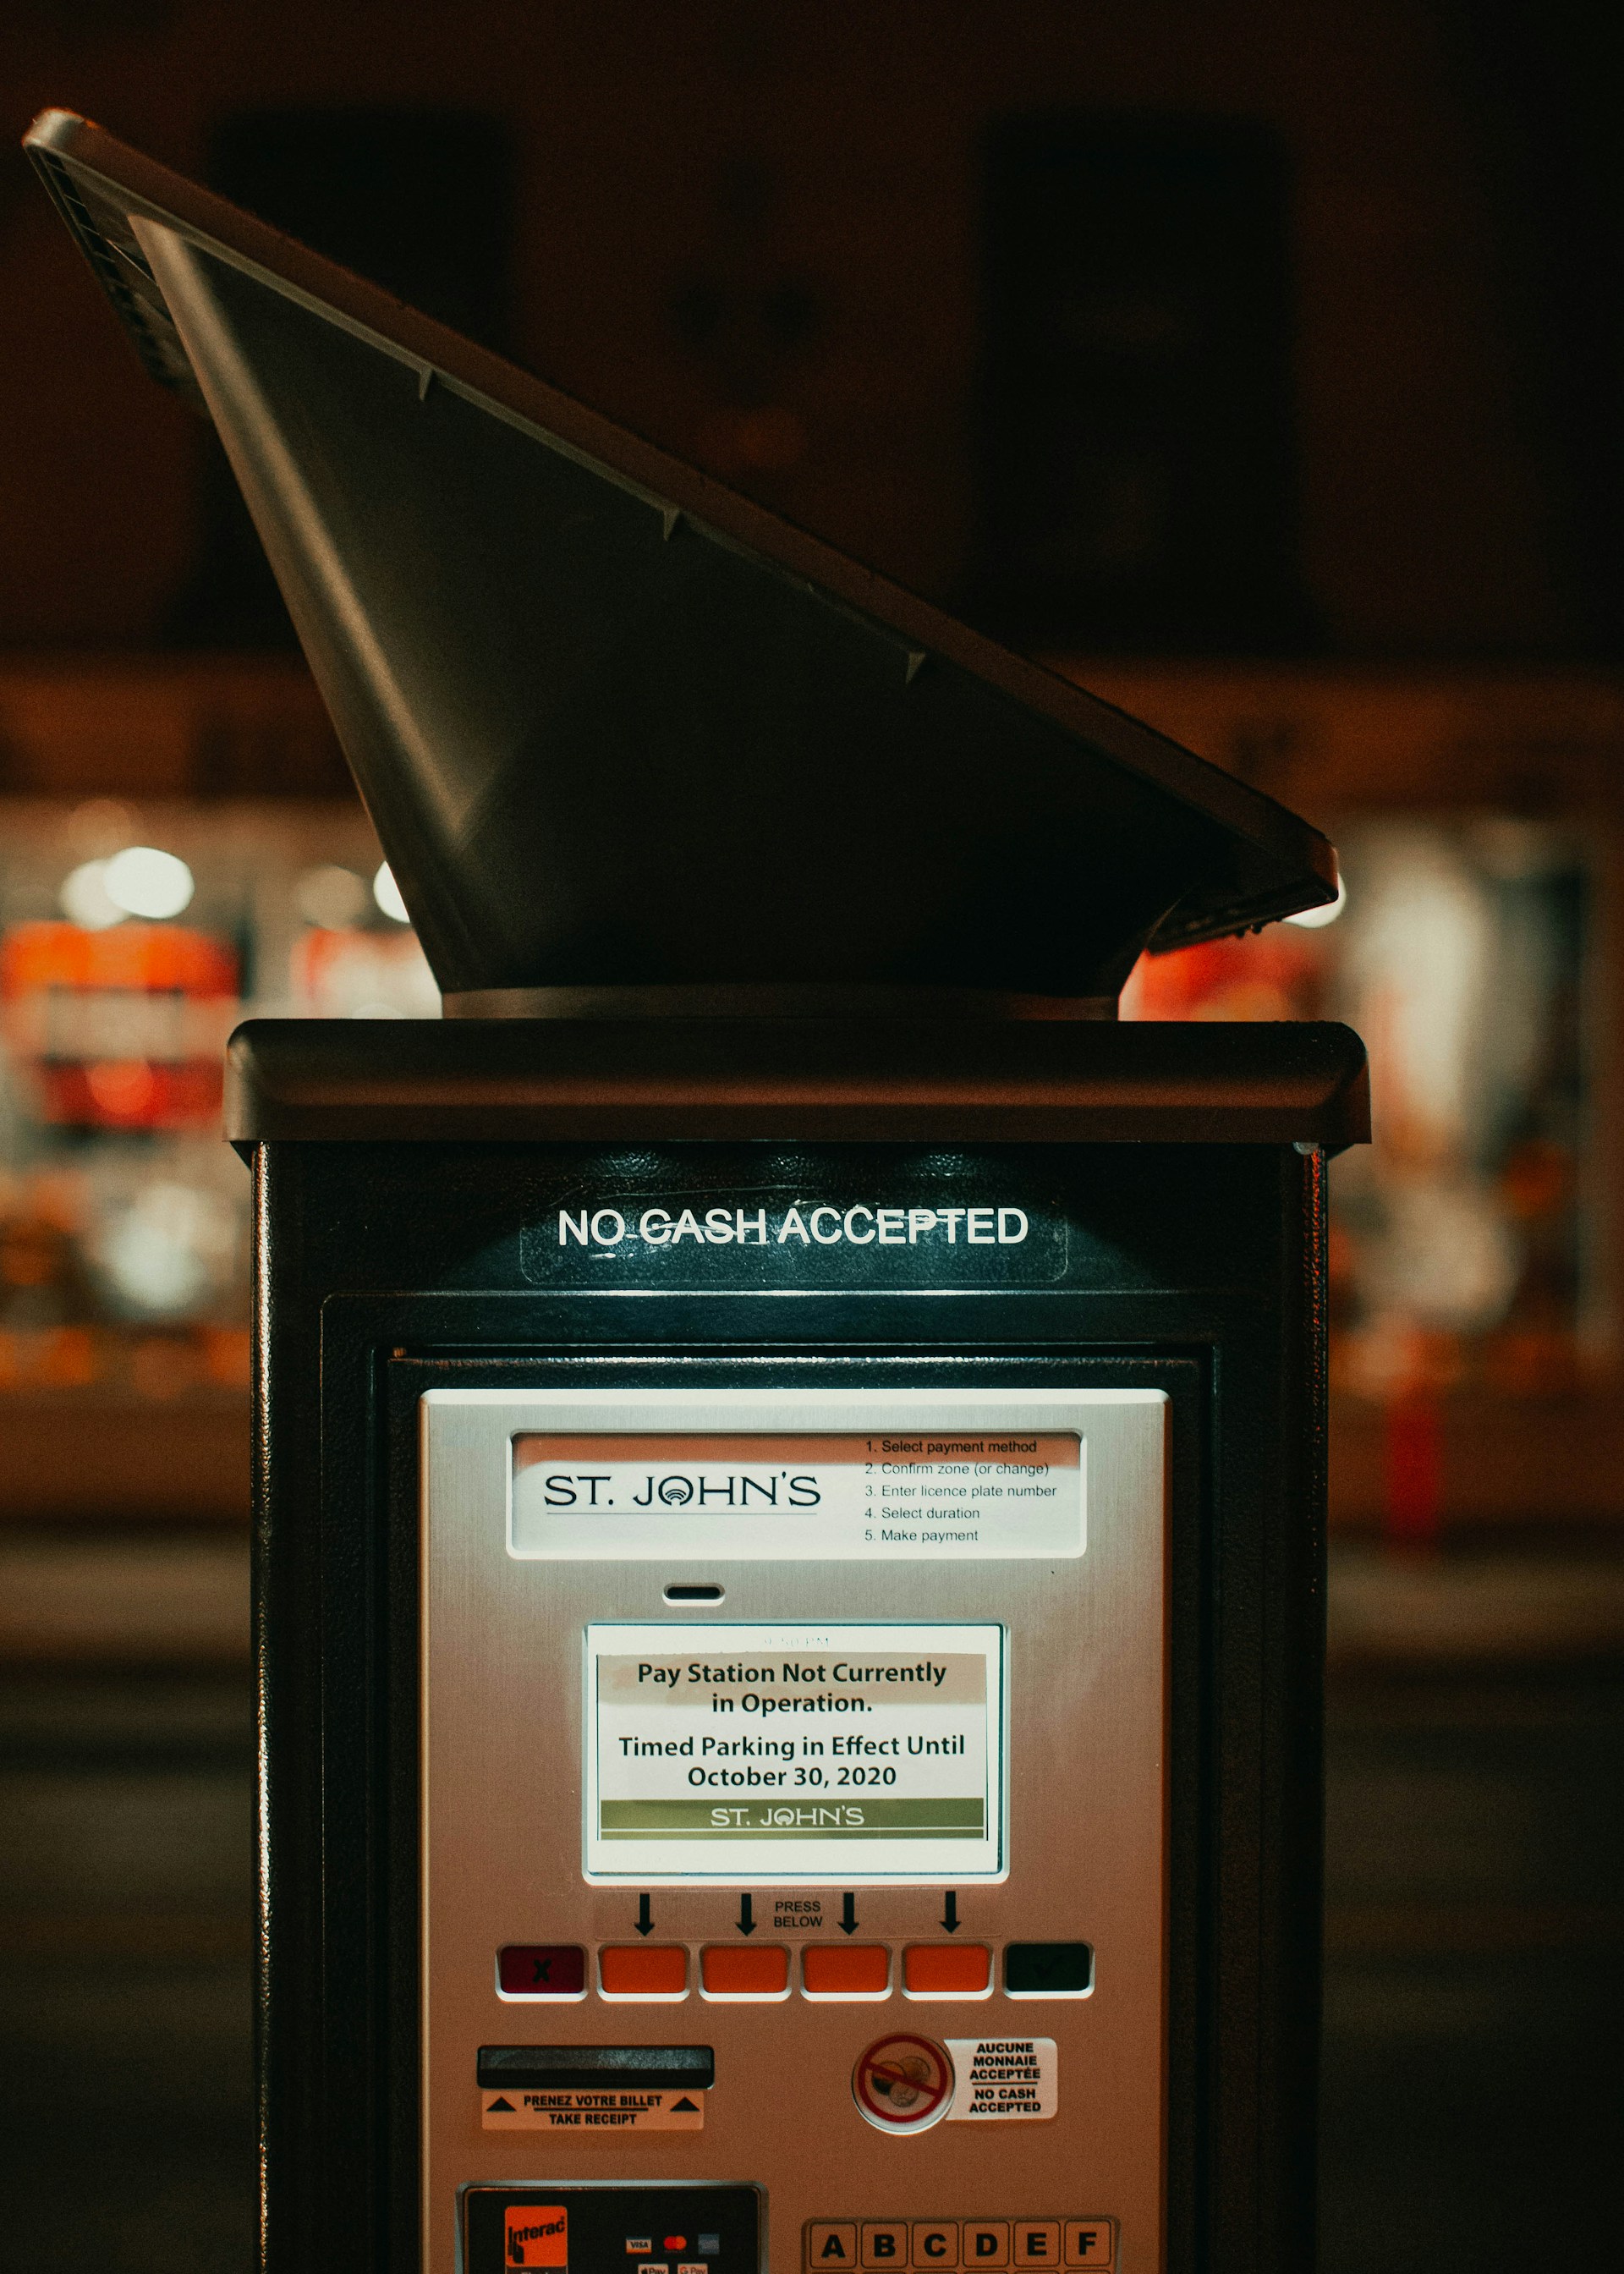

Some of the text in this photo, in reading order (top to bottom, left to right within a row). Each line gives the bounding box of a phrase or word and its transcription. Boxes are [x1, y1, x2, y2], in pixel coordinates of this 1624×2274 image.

[558, 1207, 1029, 1246] NO CASH ACCEPTED
[866, 1440, 1037, 1456] 1. Select payment method
[865, 1462, 1049, 1477] 2. Confirm zone (or change)
[544, 1471, 821, 1507] ST. JOHN'S
[864, 1485, 1057, 1499] 3. Enter licence plate number
[864, 1507, 980, 1519] 4. Select duration
[864, 1529, 979, 1544] 5. Make payment
[638, 1661, 946, 1687] Pay Station Not Currently
[712, 1692, 872, 1716] in Operation.
[618, 1734, 964, 1761] Timed Parking in Effect Until
[688, 1766, 897, 1788] October 30, 2020
[711, 1805, 864, 1826] ST. JOHN'S
[774, 1900, 821, 1913] PRESS
[773, 1915, 824, 1928] BELOW
[976, 2042, 1034, 2054] AUCUNE
[973, 2055, 1038, 2067] MONNAIE
[968, 2067, 1041, 2079] ACCEPTÉE
[524, 2095, 663, 2106] PRENEZ VOTRE BILLET
[974, 2088, 1036, 2101] NO CASH
[968, 2101, 1041, 2113] ACCEPTED
[548, 2112, 638, 2125] TAKE RECEIPT
[508, 2220, 565, 2243] Interac
[820, 2232, 1097, 2258] A B C D E F
